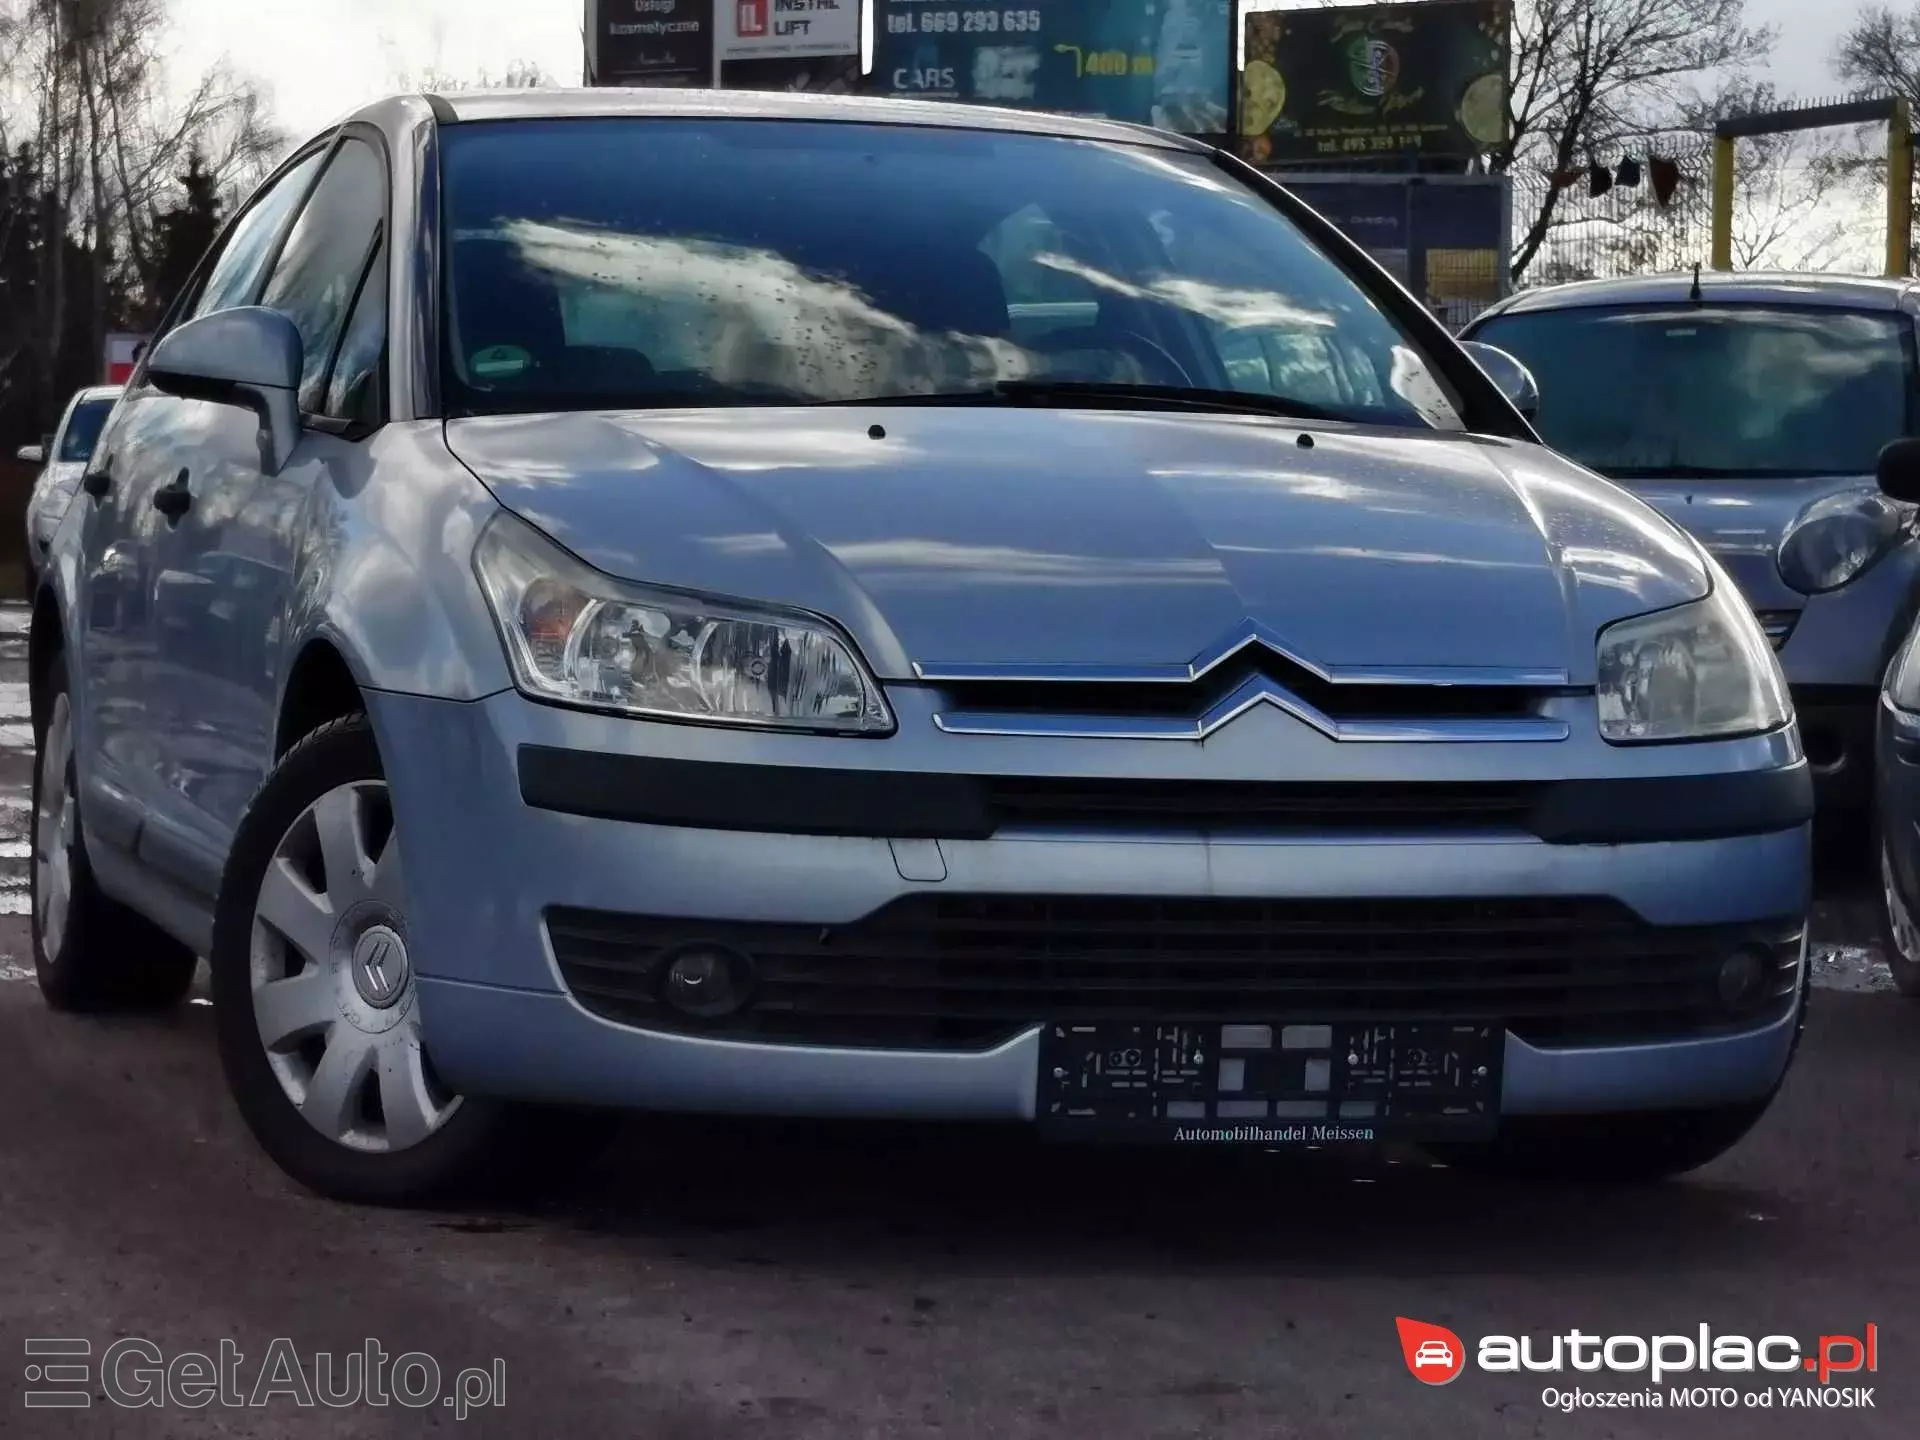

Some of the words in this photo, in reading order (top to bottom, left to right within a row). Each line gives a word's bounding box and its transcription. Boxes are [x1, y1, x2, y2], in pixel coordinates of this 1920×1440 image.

[775, 20, 812, 36] LIFT
[887, 12, 917, 33] tel.
[921, 11, 959, 32] 669
[1003, 10, 1041, 32] 635
[893, 67, 955, 90] CARS
[1174, 1126, 1306, 1141] Automobilhandel
[1311, 1125, 1374, 1140] Meissen
